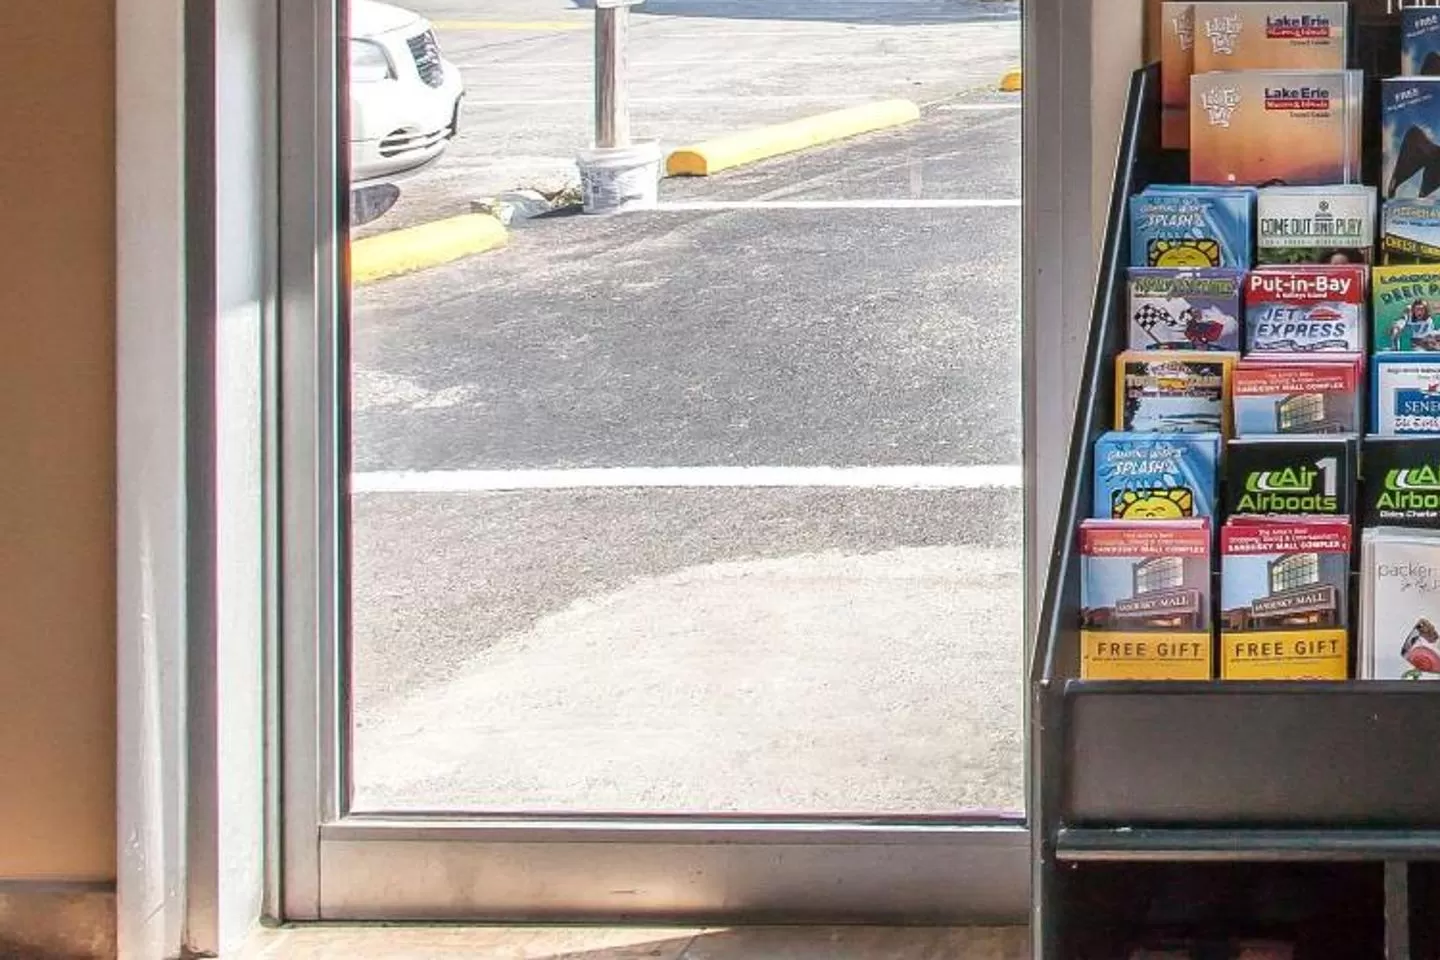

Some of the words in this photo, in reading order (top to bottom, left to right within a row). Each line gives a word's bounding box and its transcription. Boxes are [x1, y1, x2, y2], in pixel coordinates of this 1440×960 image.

[1266, 15, 1299, 27] Lake
[1301, 15, 1329, 27] Erie
[1264, 87, 1299, 99] Lake
[1301, 87, 1330, 99] Erie
[1260, 218, 1291, 236] COME
[1291, 218, 1312, 235] OUT
[1335, 218, 1363, 235] PLAY
[1251, 276, 1352, 294] Put-in-Bay
[1380, 285, 1424, 304] DEER
[1261, 308, 1294, 322] JET
[1257, 323, 1346, 339] EXPRESS
[1281, 466, 1317, 487] Air
[1316, 457, 1338, 496] 1
[1236, 494, 1338, 511] Airboats
[1378, 562, 1432, 580] packer
[1160, 596, 1188, 608] MALL
[1297, 593, 1326, 606] MALL
[1097, 642, 1148, 657] FREE
[1156, 642, 1201, 657] GIFT
[1235, 641, 1284, 657] FREE
[1294, 639, 1338, 656] GIFT
